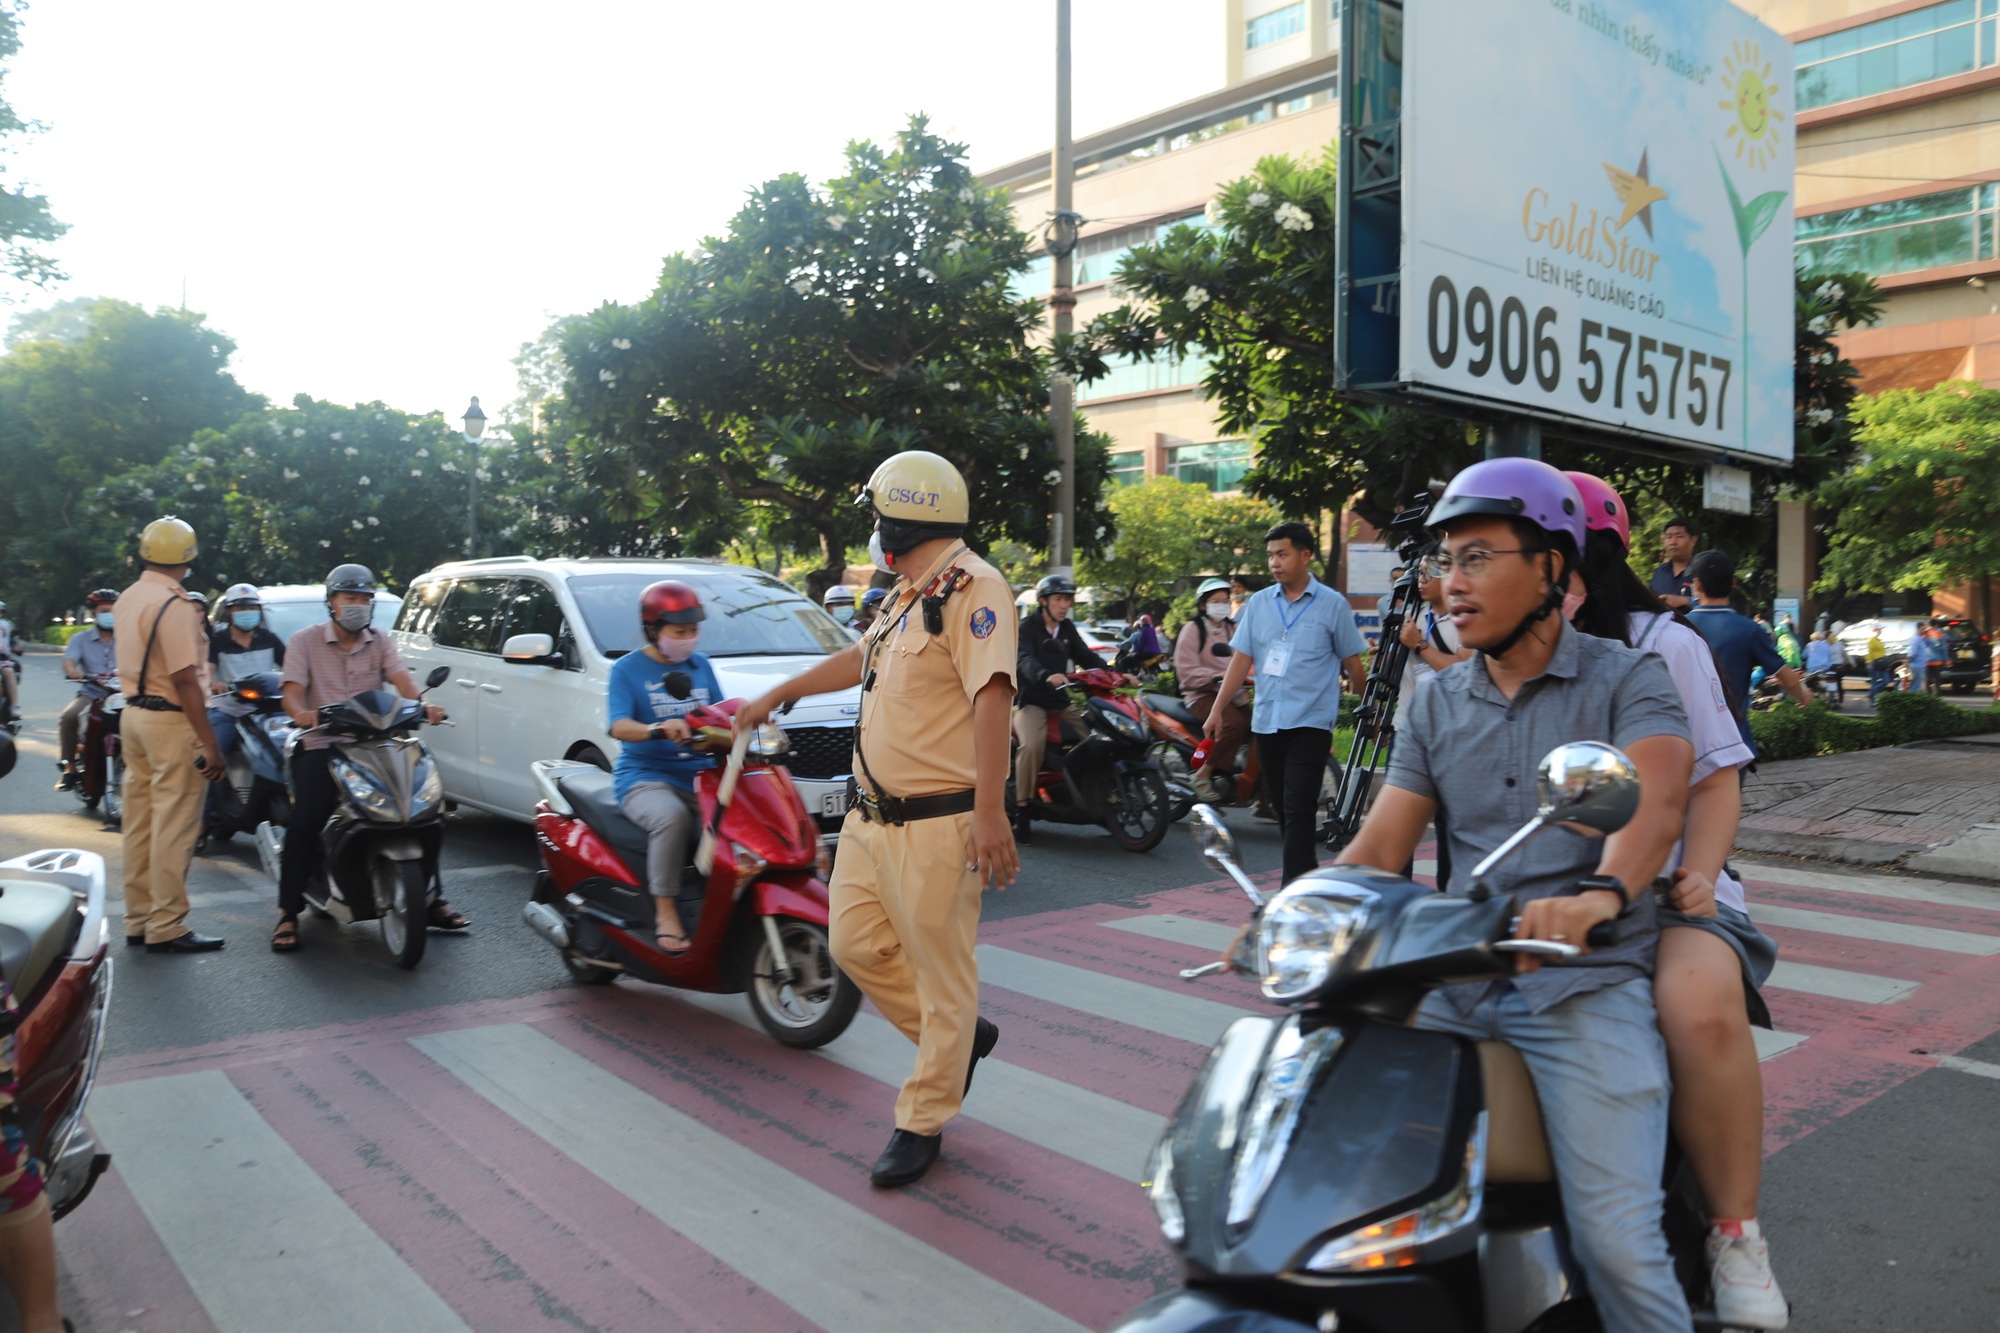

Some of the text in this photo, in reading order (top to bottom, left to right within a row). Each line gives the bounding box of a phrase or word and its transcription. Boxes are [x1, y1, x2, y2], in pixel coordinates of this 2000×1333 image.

[1624, 25, 1662, 67] thấy
[1521, 187, 1661, 283] GoldStar
[1526, 256, 1665, 319] LIÊN HỆ QUẢNG CÁO
[1428, 275, 1731, 431] 0906 575757
[888, 487, 940, 507] CSGT
